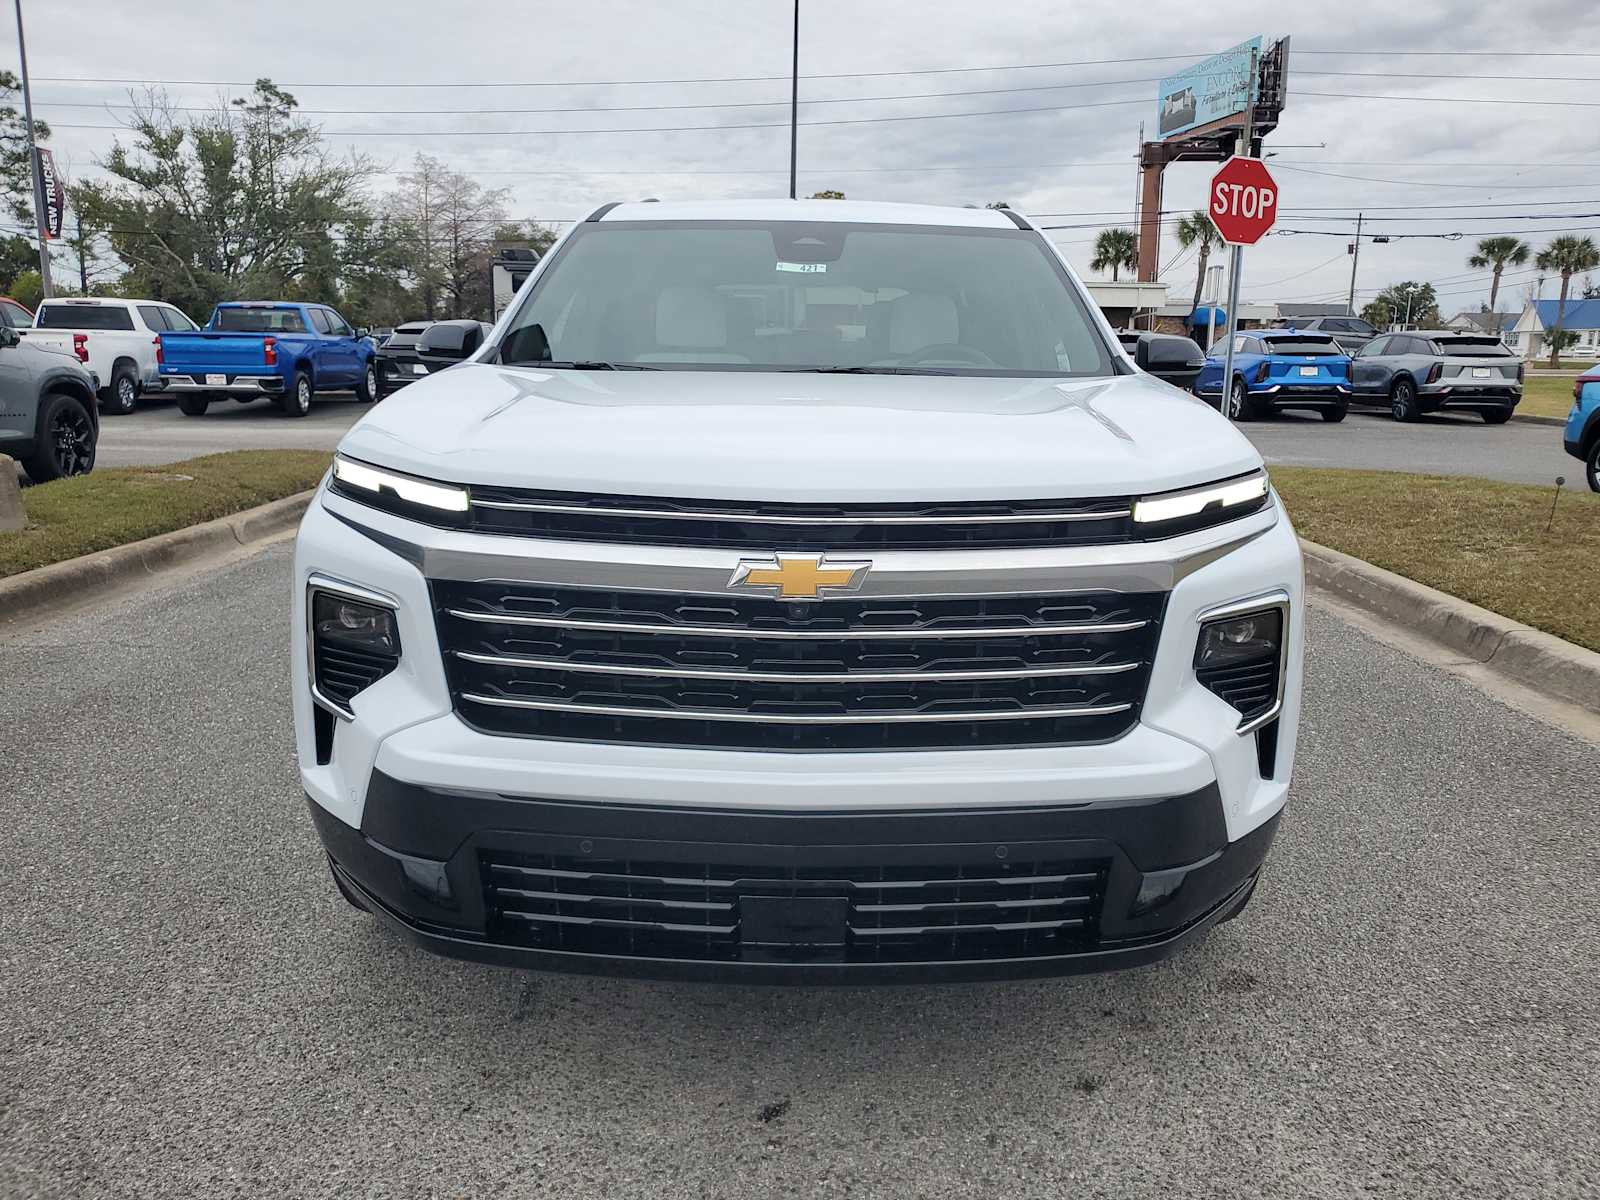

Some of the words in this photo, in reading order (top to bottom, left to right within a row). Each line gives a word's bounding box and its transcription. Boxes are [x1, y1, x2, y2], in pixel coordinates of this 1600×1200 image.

[42, 154, 56, 204] TRUCKS
[1213, 183, 1274, 218] STOP
[48, 207, 57, 234] NEW
